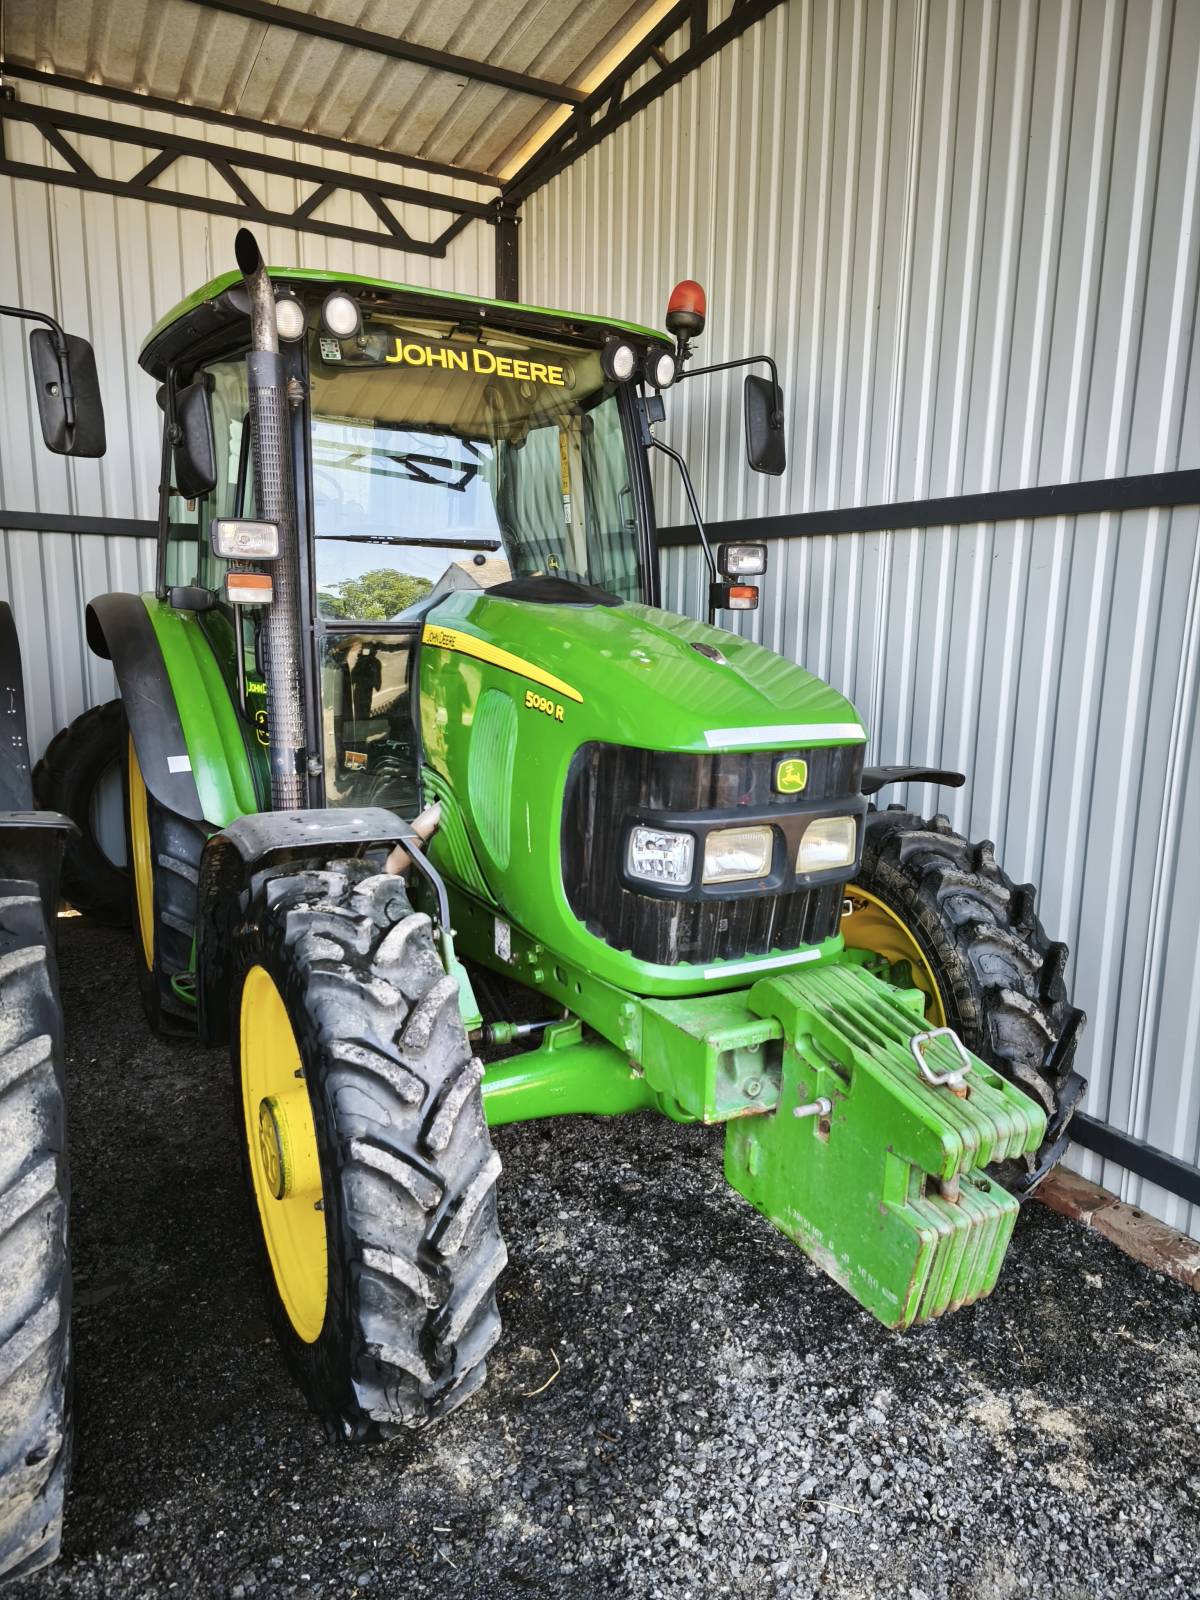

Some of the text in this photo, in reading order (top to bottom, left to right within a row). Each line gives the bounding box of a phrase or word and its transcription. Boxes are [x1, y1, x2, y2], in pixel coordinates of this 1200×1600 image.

[386, 338, 565, 385] JOHN DEERE
[525, 689, 565, 721] 5090 R
